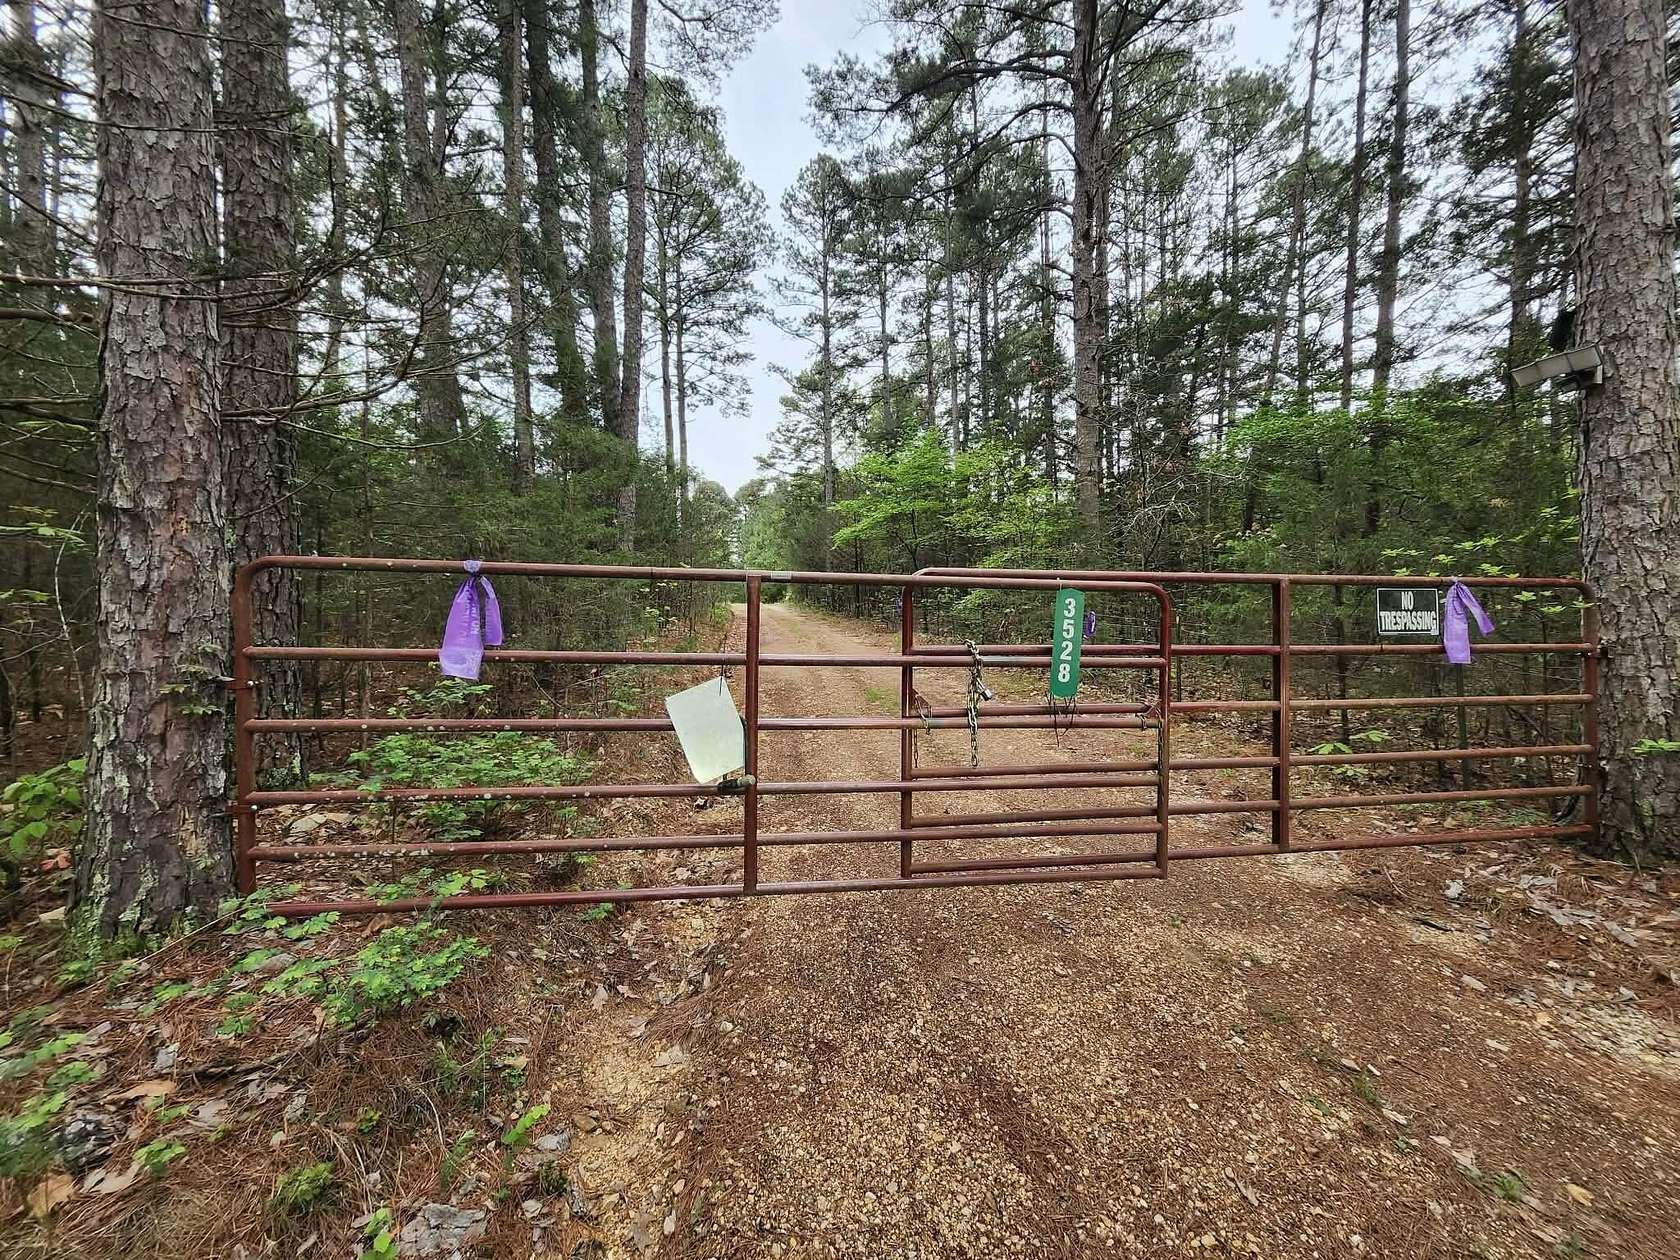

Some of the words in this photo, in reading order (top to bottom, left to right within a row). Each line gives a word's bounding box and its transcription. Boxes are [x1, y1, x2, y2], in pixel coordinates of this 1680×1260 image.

[1401, 591, 1414, 610] NO
[1380, 611, 1437, 631] TRESPASSING
[1058, 597, 1076, 683] 3528
